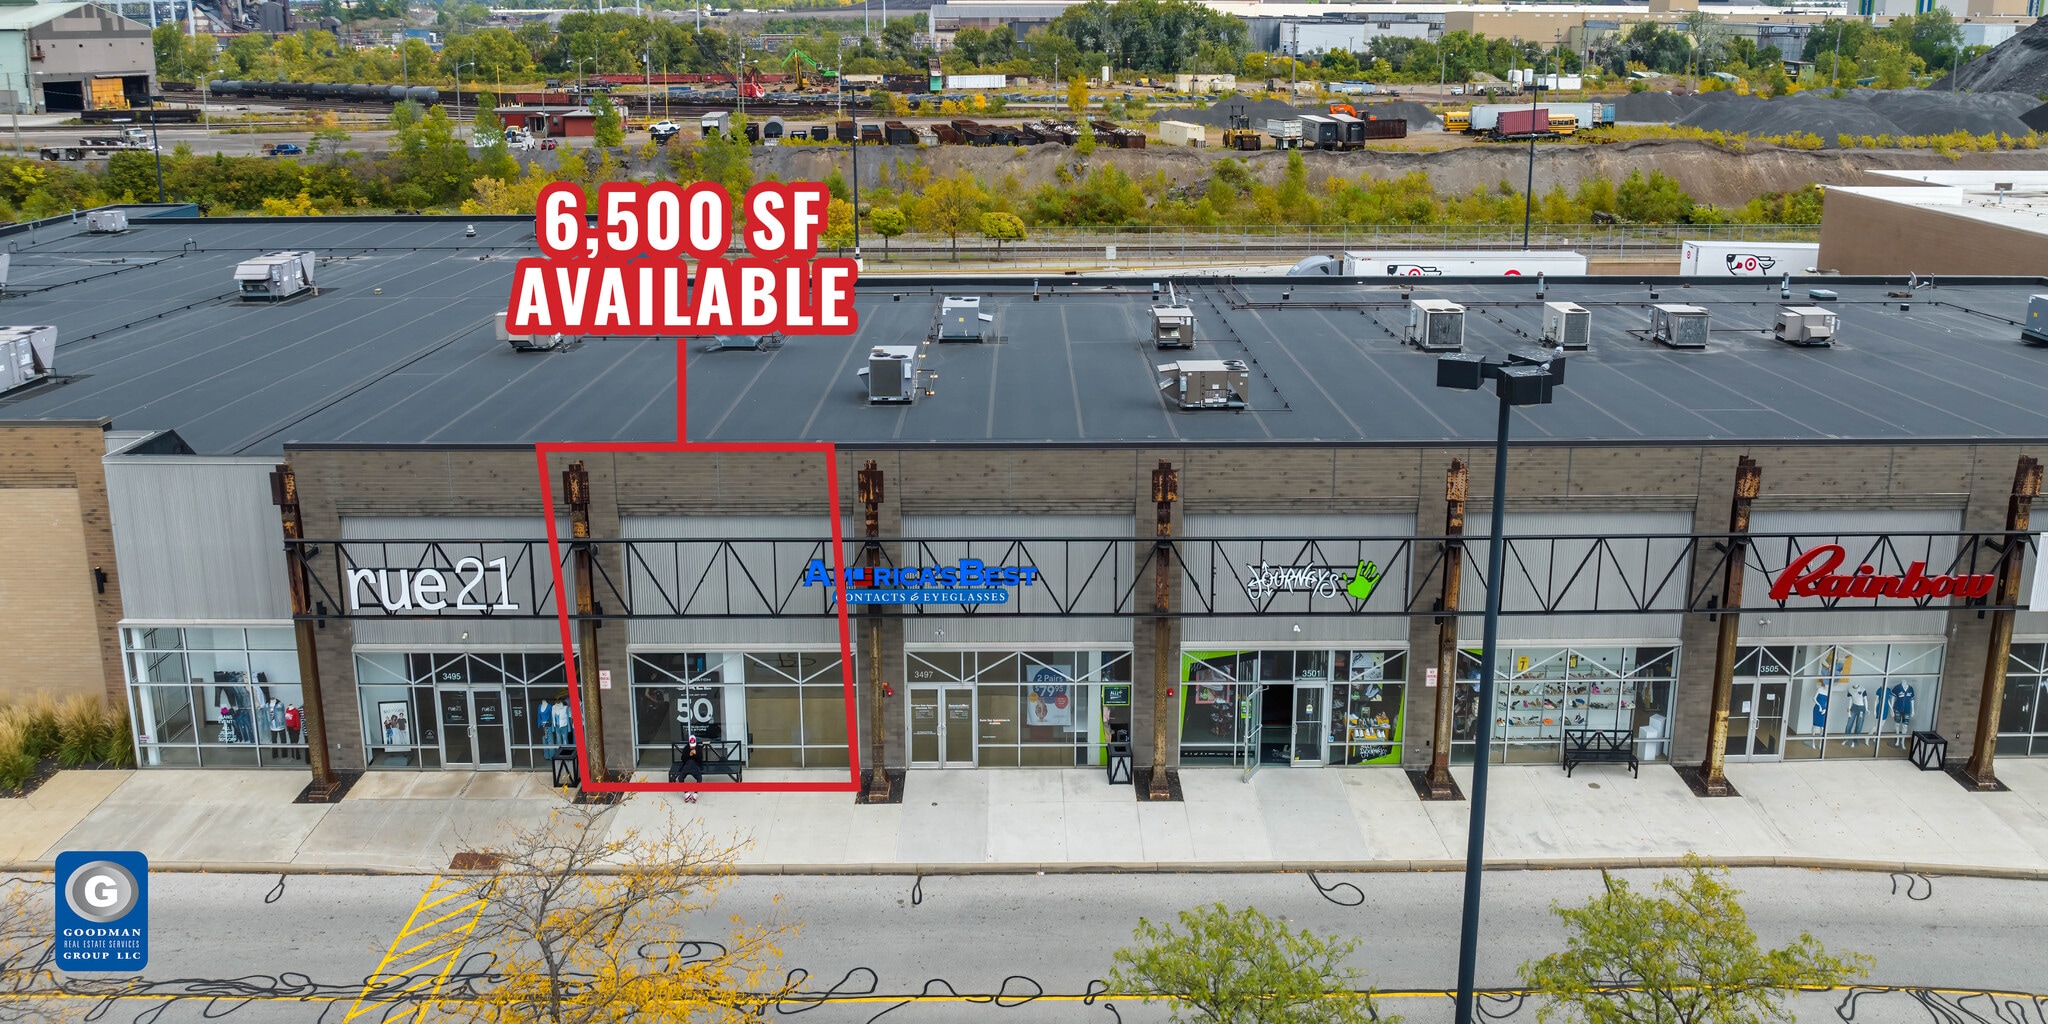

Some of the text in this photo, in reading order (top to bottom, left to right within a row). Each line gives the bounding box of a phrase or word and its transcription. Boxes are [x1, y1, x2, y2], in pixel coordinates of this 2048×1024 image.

[1769, 543, 1995, 600] Rainbow
[1246, 560, 1339, 600] JOURNEYS
[835, 592, 906, 602] ONTACTS
[923, 592, 1006, 602] EYEGLASSES
[1302, 669, 1321, 678] 3501
[1760, 665, 1780, 673] 3505
[442, 672, 462, 681] 3495
[914, 671, 934, 679] 3497
[676, 697, 714, 723] 50
